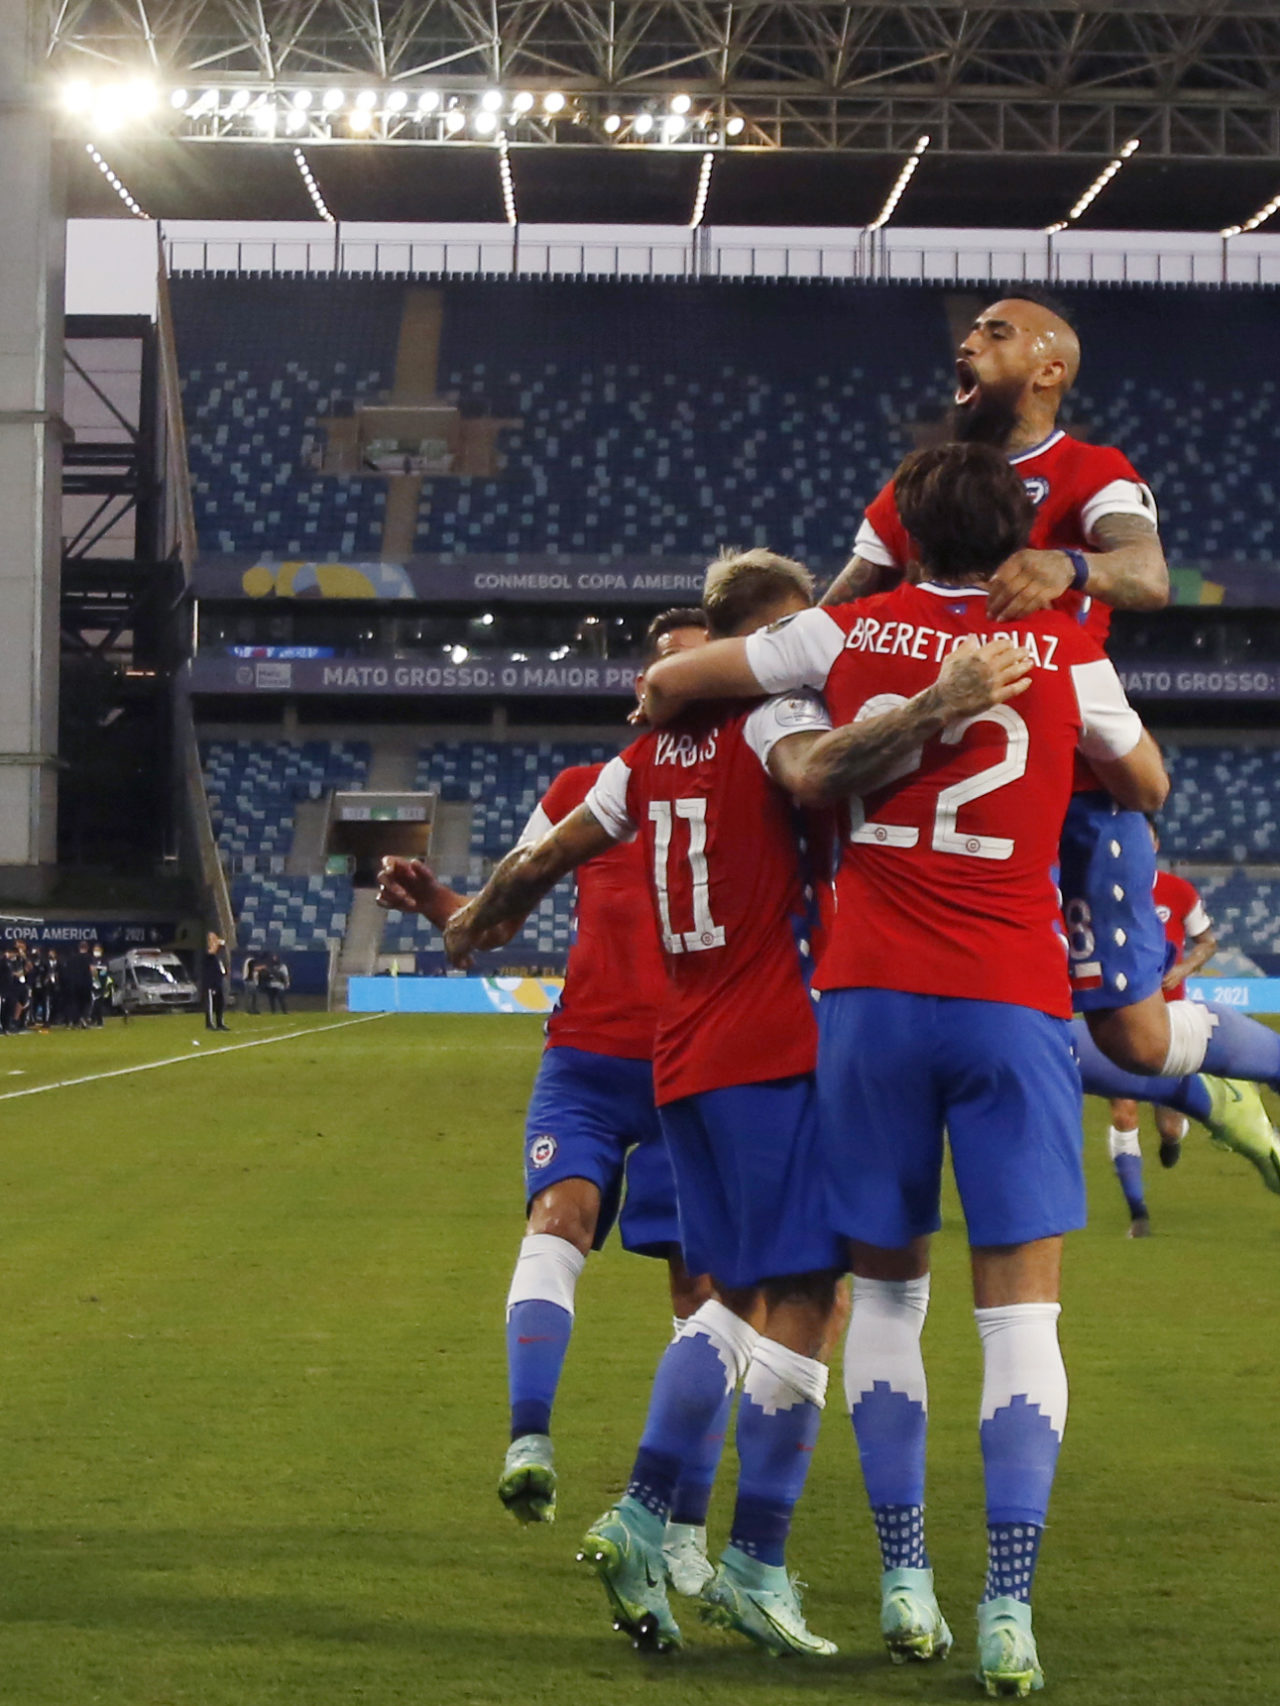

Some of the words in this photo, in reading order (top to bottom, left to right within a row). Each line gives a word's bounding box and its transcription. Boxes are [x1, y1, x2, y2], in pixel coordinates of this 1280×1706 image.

[474, 574, 572, 589] CONMEBOL
[578, 574, 627, 589] COPA
[632, 574, 704, 590] AMERIC
[323, 667, 388, 686] MATO
[394, 668, 495, 687] GROSSO:
[502, 668, 517, 687] O
[523, 668, 599, 687] MAIOR
[1176, 672, 1275, 691] GROSSO:
[654, 728, 719, 768] VARS
[648, 798, 726, 953] 11
[5, 927, 38, 940] COPA
[42, 928, 98, 940] AMERICA
[1066, 899, 1095, 960] 8
[1214, 987, 1248, 1005] 2021
